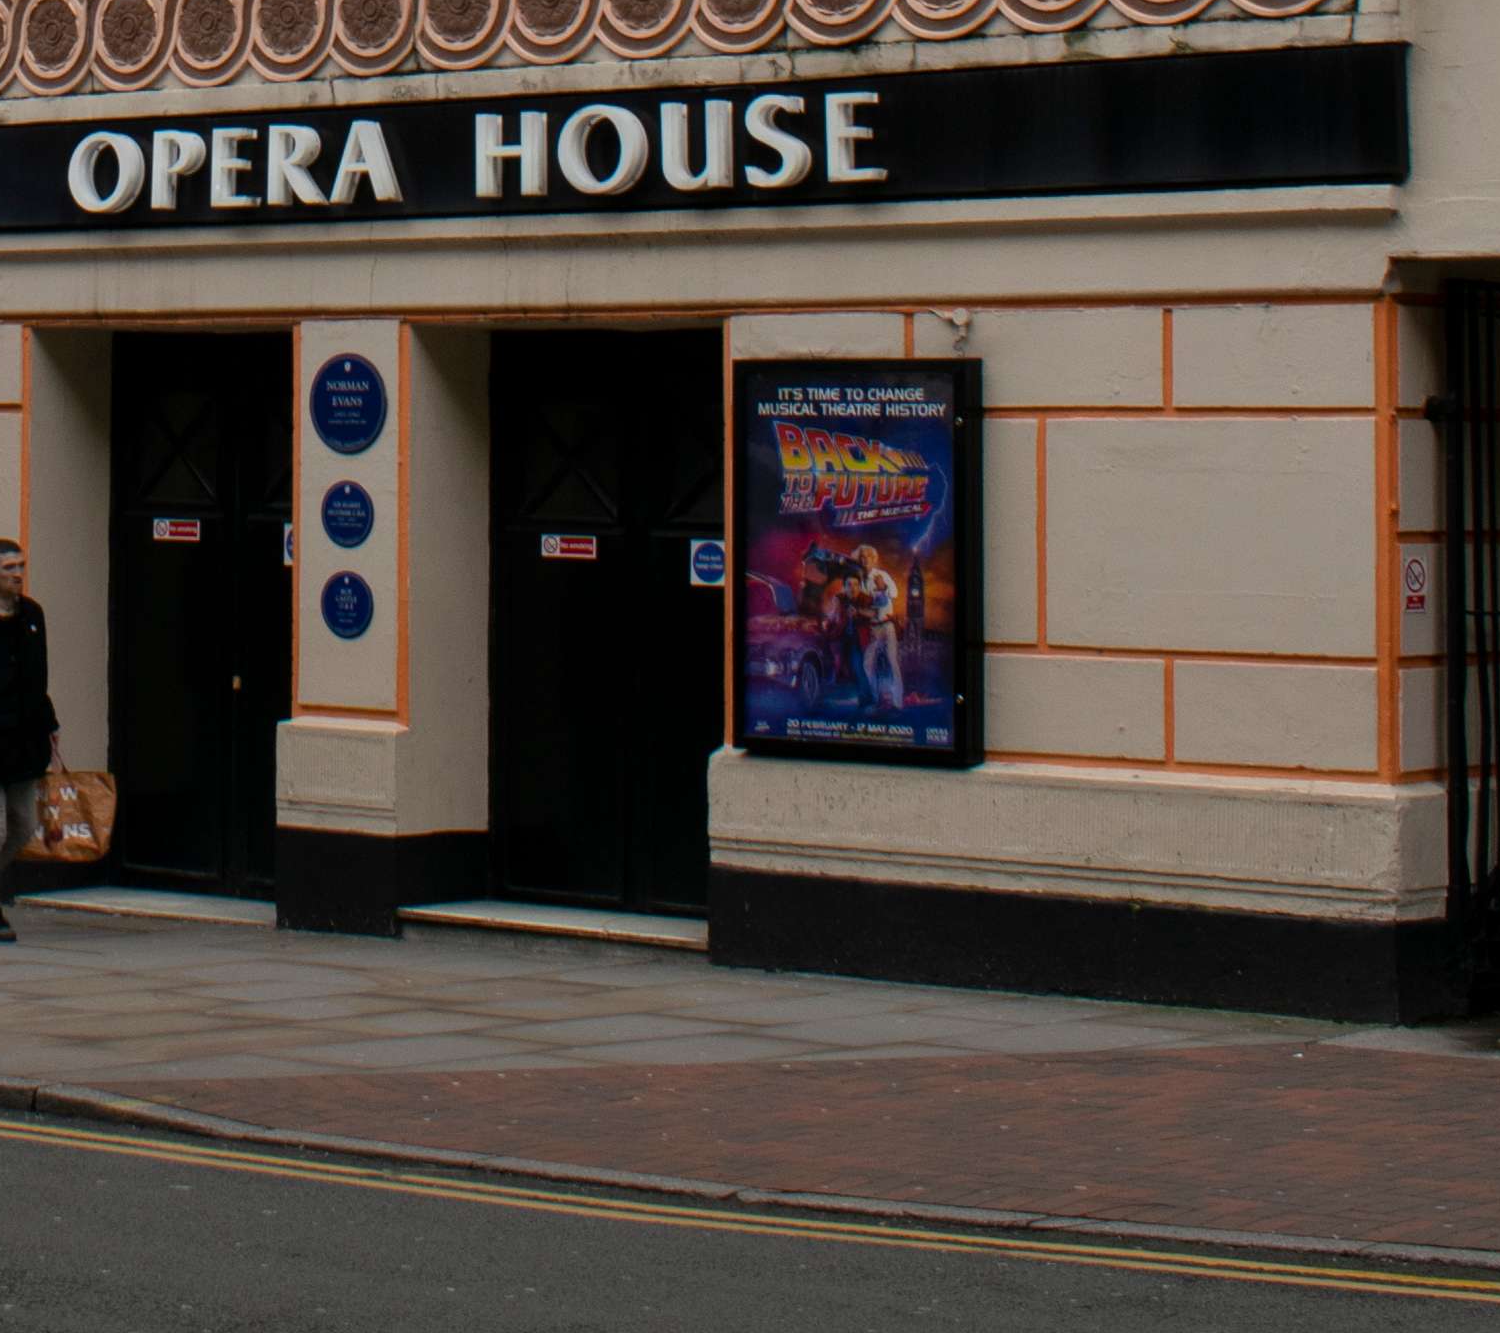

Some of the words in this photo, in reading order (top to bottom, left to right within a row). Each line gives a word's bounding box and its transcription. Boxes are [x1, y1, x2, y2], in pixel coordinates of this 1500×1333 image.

[65, 119, 403, 215] OPERA
[473, 90, 890, 200] HOUSE
[326, 380, 370, 391] NORMAN
[331, 395, 363, 406] EVANS
[777, 387, 803, 402] IT'S
[806, 387, 840, 402] TIME
[845, 387, 864, 402] TO
[867, 387, 925, 402] CHANGE
[757, 402, 818, 416] MUSICAL
[820, 402, 881, 417] THEATRE
[885, 403, 947, 418] HISTORY
[773, 421, 900, 473] BACK
[783, 472, 813, 494] TO
[813, 472, 929, 511] FUTURE
[857, 510, 878, 521] THE
[879, 503, 924, 517] MUSICAL
[786, 718, 799, 728] 20
[801, 719, 849, 731] FEBRUARY
[868, 724, 887, 733] MAY
[888, 726, 914, 735] 2020
